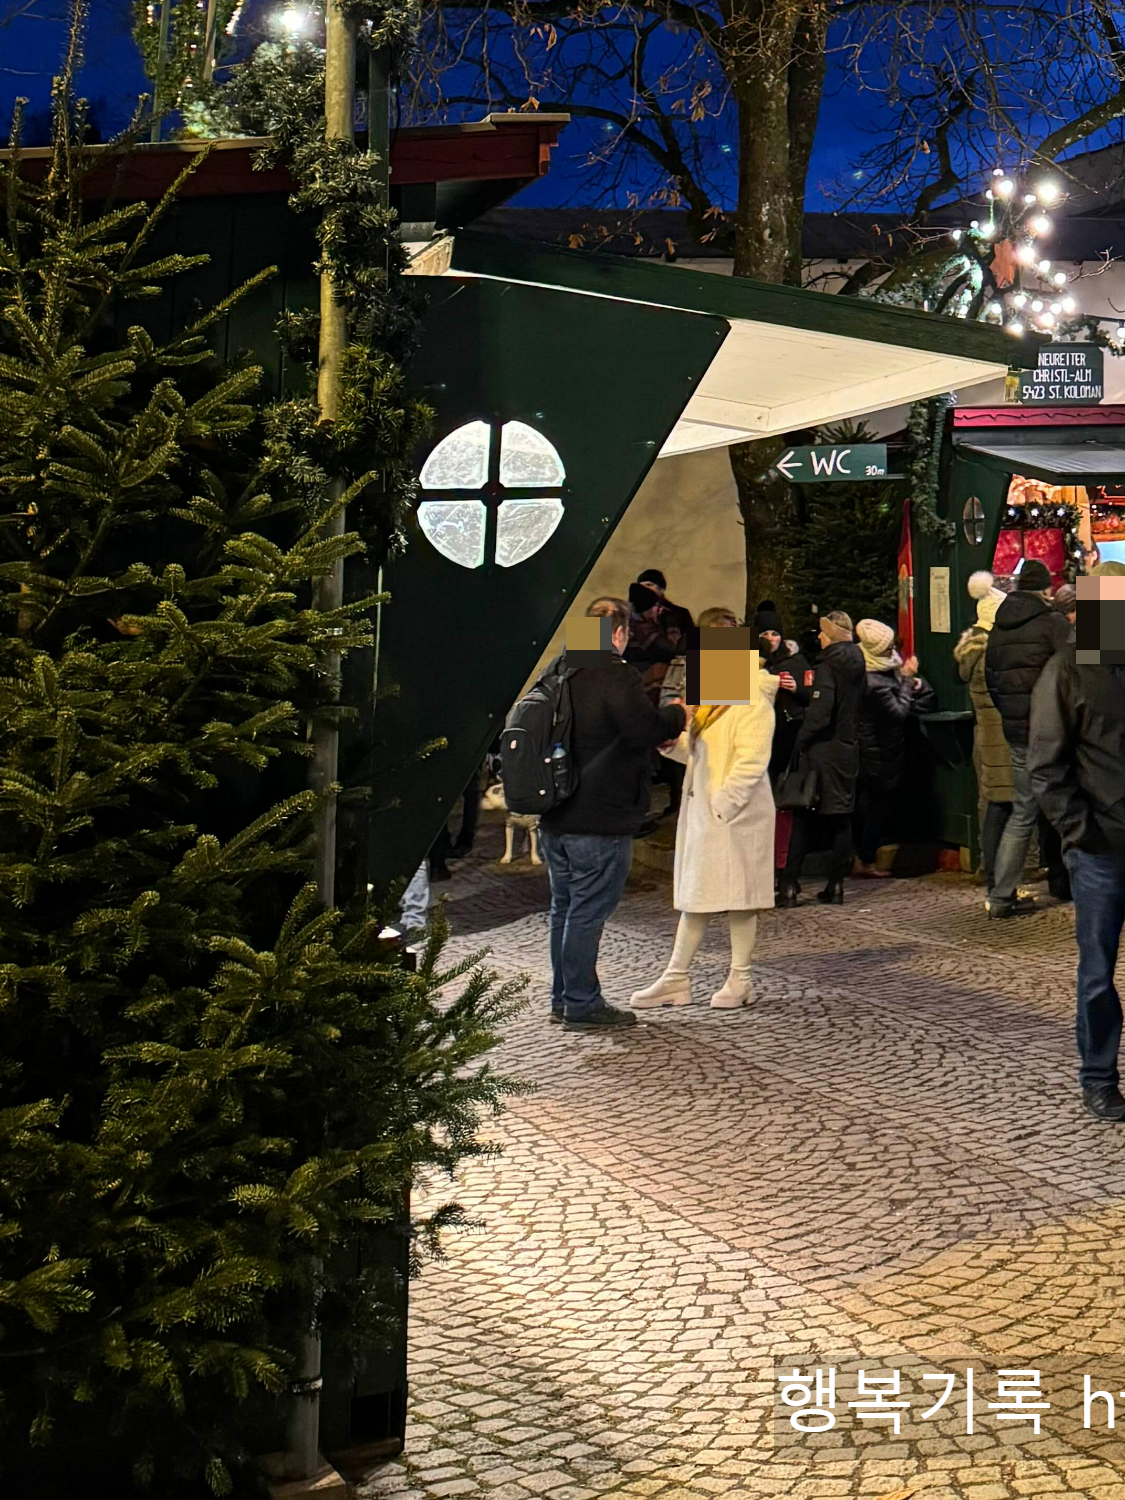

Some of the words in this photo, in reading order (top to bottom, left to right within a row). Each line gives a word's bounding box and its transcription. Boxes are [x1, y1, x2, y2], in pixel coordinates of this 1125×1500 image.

[1038, 352, 1086, 367] NEUREITER
[1033, 368, 1092, 383] CHRISTL-ALM
[1022, 385, 1045, 399] 5423
[1048, 385, 1063, 399] ST.
[1064, 385, 1102, 399] KOLOMAN
[810, 449, 851, 476] WC
[865, 465, 885, 476] 30m
